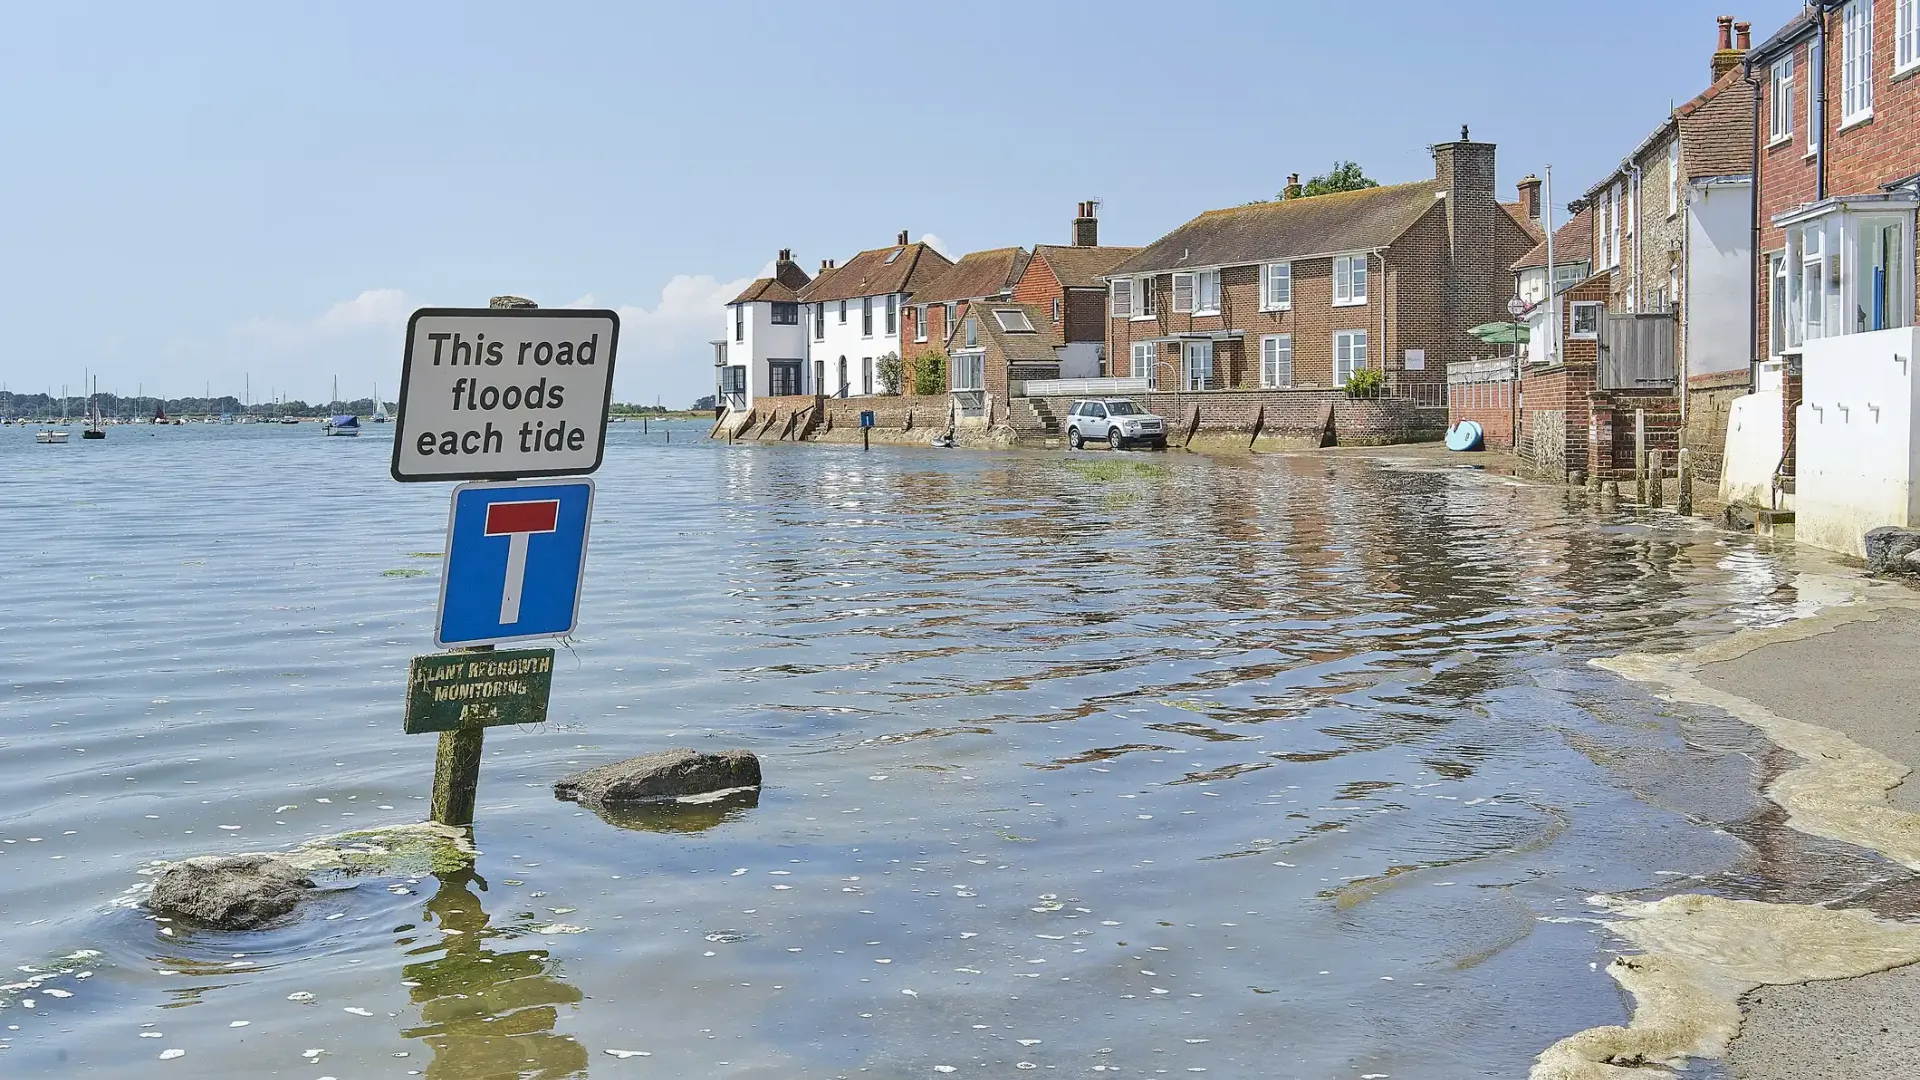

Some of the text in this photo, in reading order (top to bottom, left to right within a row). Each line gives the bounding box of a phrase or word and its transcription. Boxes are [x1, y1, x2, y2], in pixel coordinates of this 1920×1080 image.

[428, 333, 598, 366] This road
[452, 377, 564, 411] floods
[416, 421, 585, 456] each tide
[468, 657, 550, 678] REGROWTH
[434, 680, 527, 702] MONITORING
